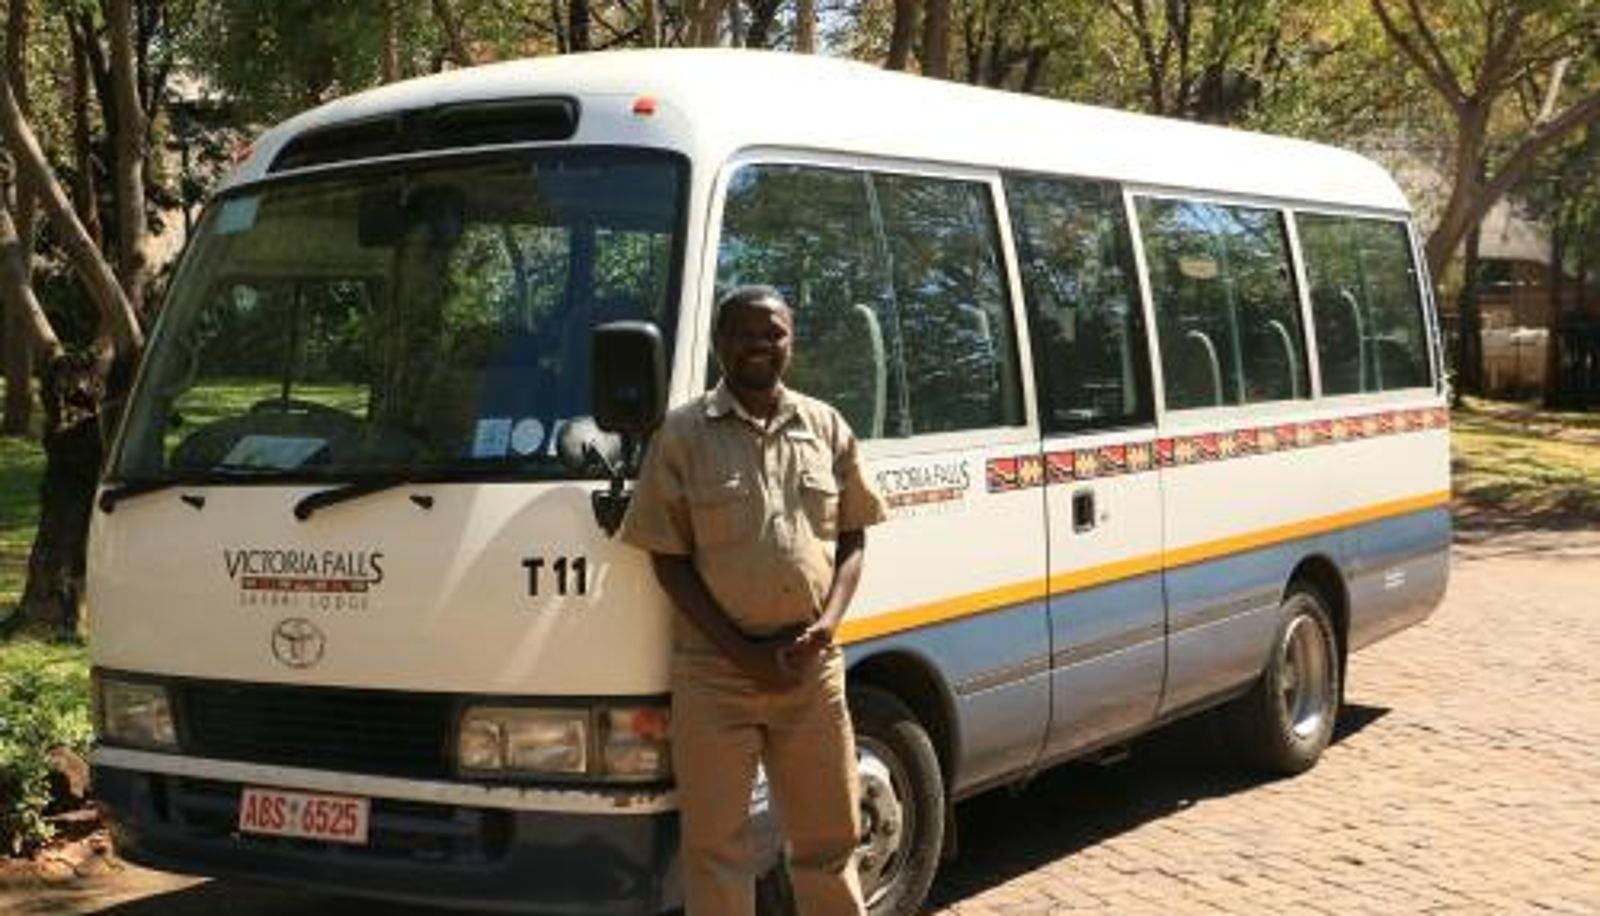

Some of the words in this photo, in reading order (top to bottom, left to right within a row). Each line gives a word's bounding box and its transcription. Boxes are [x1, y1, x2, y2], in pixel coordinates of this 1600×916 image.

[225, 549, 318, 580] VICTORIA
[321, 551, 384, 584] FALLS
[521, 558, 544, 596] T
[553, 556, 586, 596] 11
[245, 794, 286, 829] ABS
[303, 799, 359, 836] 6525
